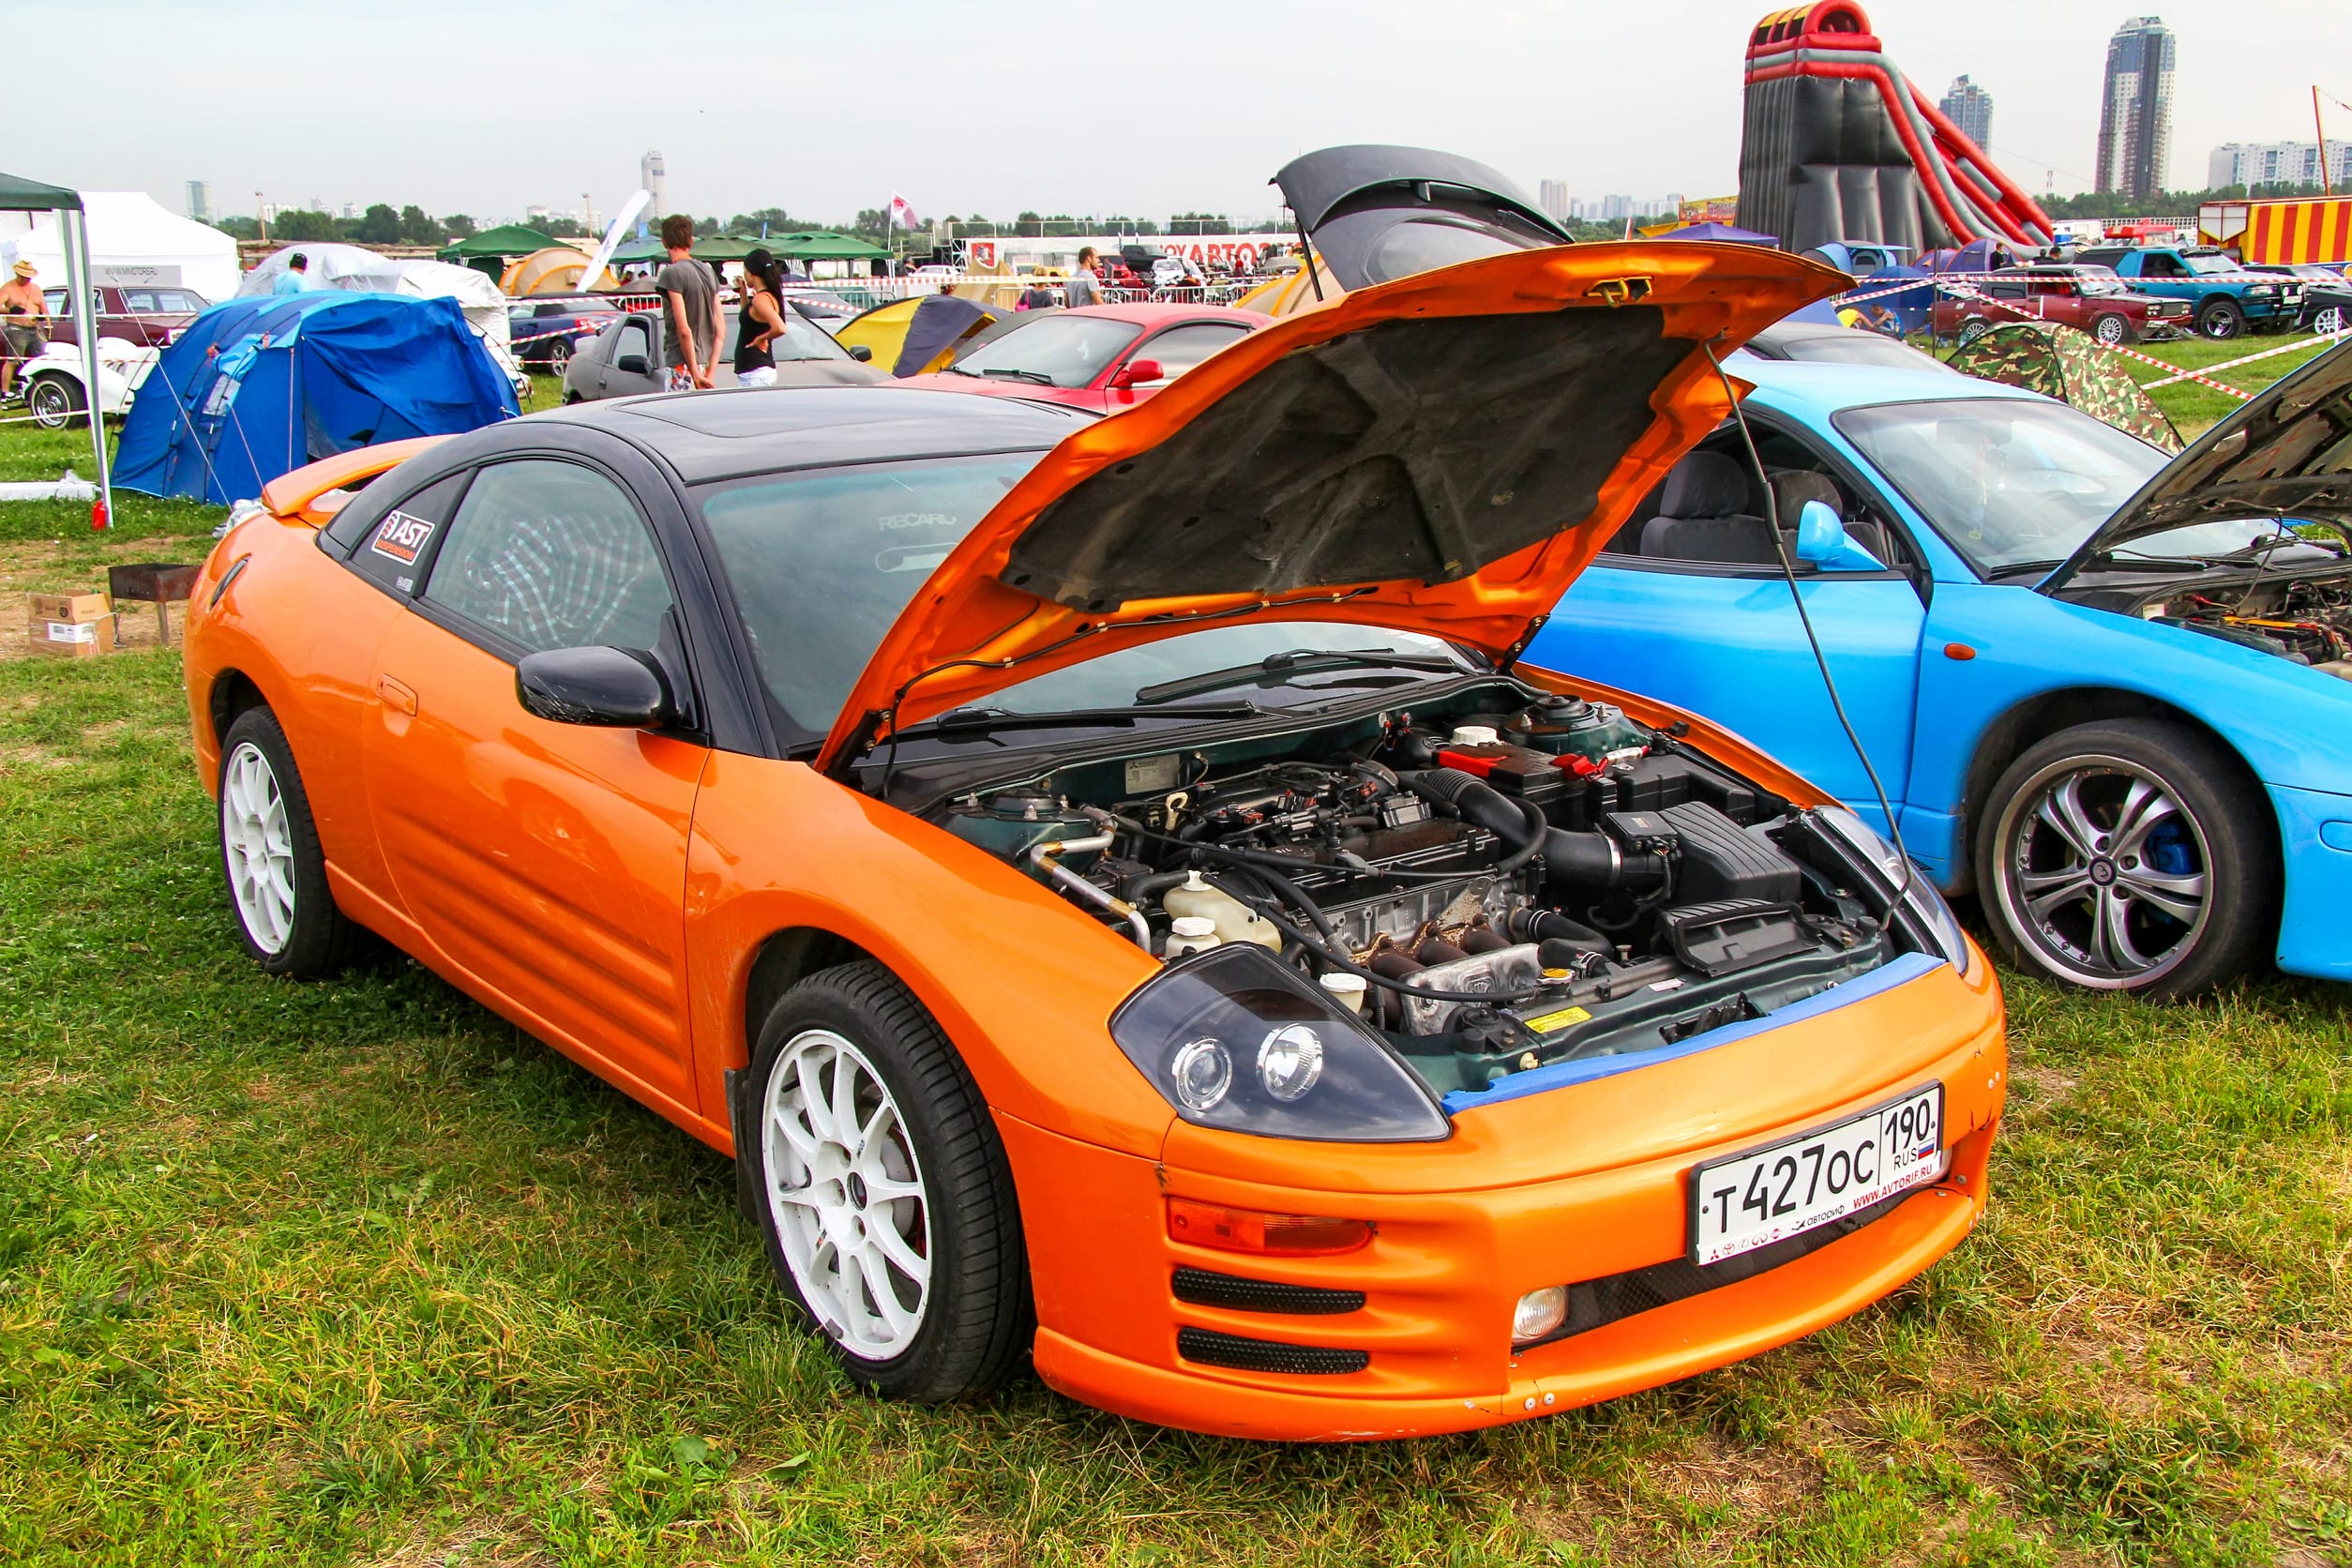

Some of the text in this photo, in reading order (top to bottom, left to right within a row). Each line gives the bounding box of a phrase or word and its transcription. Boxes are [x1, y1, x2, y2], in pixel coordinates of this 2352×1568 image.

[390, 519, 430, 549] AST
[1885, 1098, 1931, 1154] 190
[1893, 1147, 1918, 1171] RUS
[1852, 1163, 1933, 1210] WWW.AVTORIF.RU
